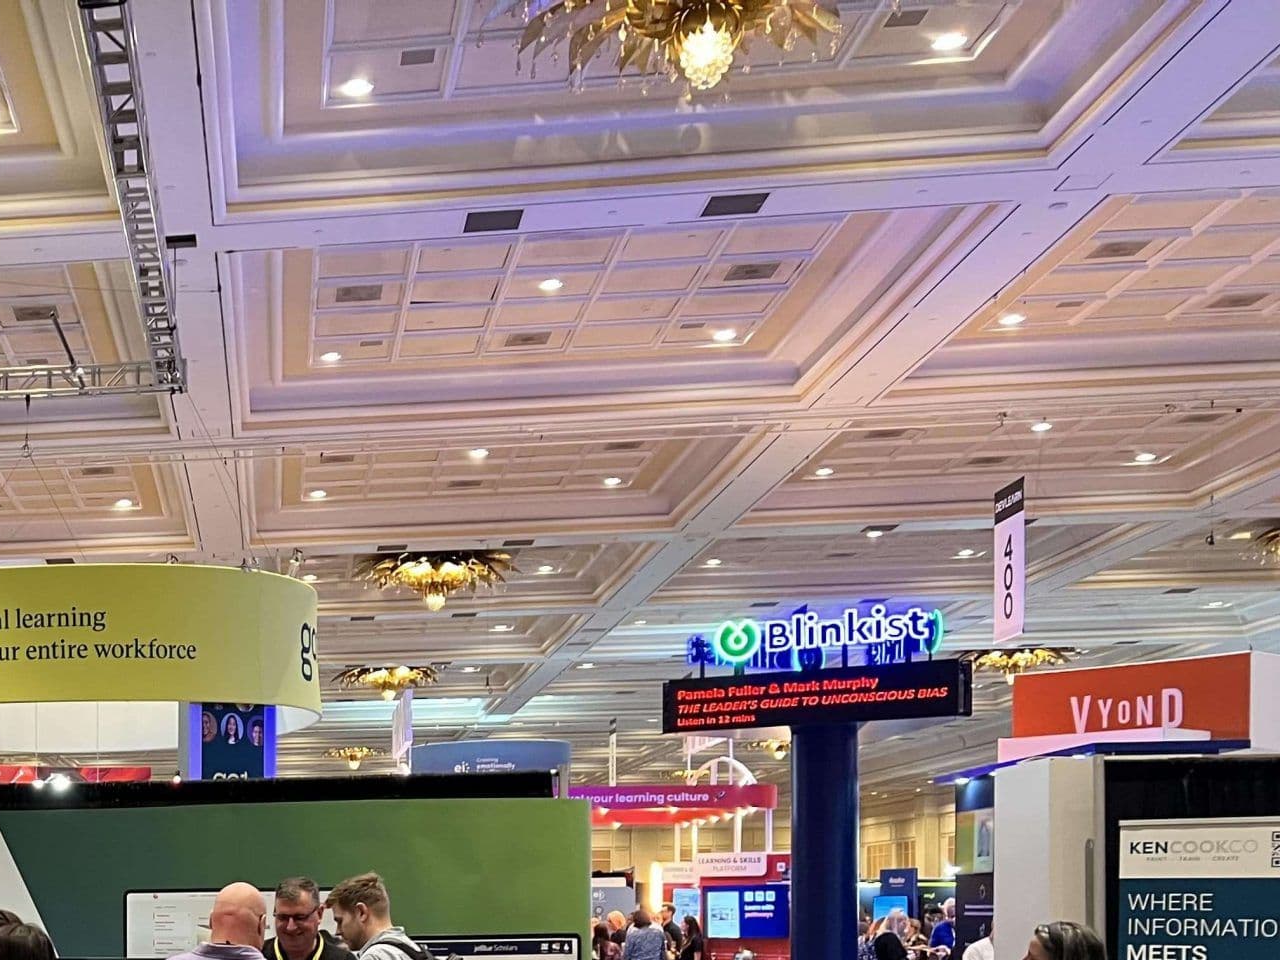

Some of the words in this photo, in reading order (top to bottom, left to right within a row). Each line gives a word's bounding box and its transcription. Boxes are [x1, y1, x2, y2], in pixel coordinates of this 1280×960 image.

[995, 490, 1022, 513] DEVLEARN
[1003, 533, 1013, 620] 400
[16, 605, 106, 633] learning
[766, 605, 930, 653] Blinkist
[26, 638, 88, 660] entire
[94, 637, 197, 661] workforce
[677, 688, 725, 701] Pamela
[728, 685, 766, 698] Fuller
[768, 683, 780, 695] &
[783, 680, 819, 693] Mark
[823, 677, 879, 691] Murphy
[678, 703, 700, 715] THE
[703, 699, 757, 713] LEADER'S
[760, 697, 799, 709] GUIDE
[802, 696, 819, 707] TO
[821, 689, 915, 706] UNCONSCIOUS
[917, 687, 948, 699] BIAS
[677, 717, 704, 727] Listen
[707, 715, 717, 725] in
[719, 714, 730, 724] 12
[732, 713, 756, 724] mins
[1070, 688, 1183, 734] VYOND
[615, 792, 665, 804] learning
[667, 792, 709, 802] culture
[698, 856, 731, 865] LEARNING
[740, 855, 762, 864] SKILLS
[1128, 892, 1214, 911] WHERE
[1128, 917, 1278, 938] INFORMATIO
